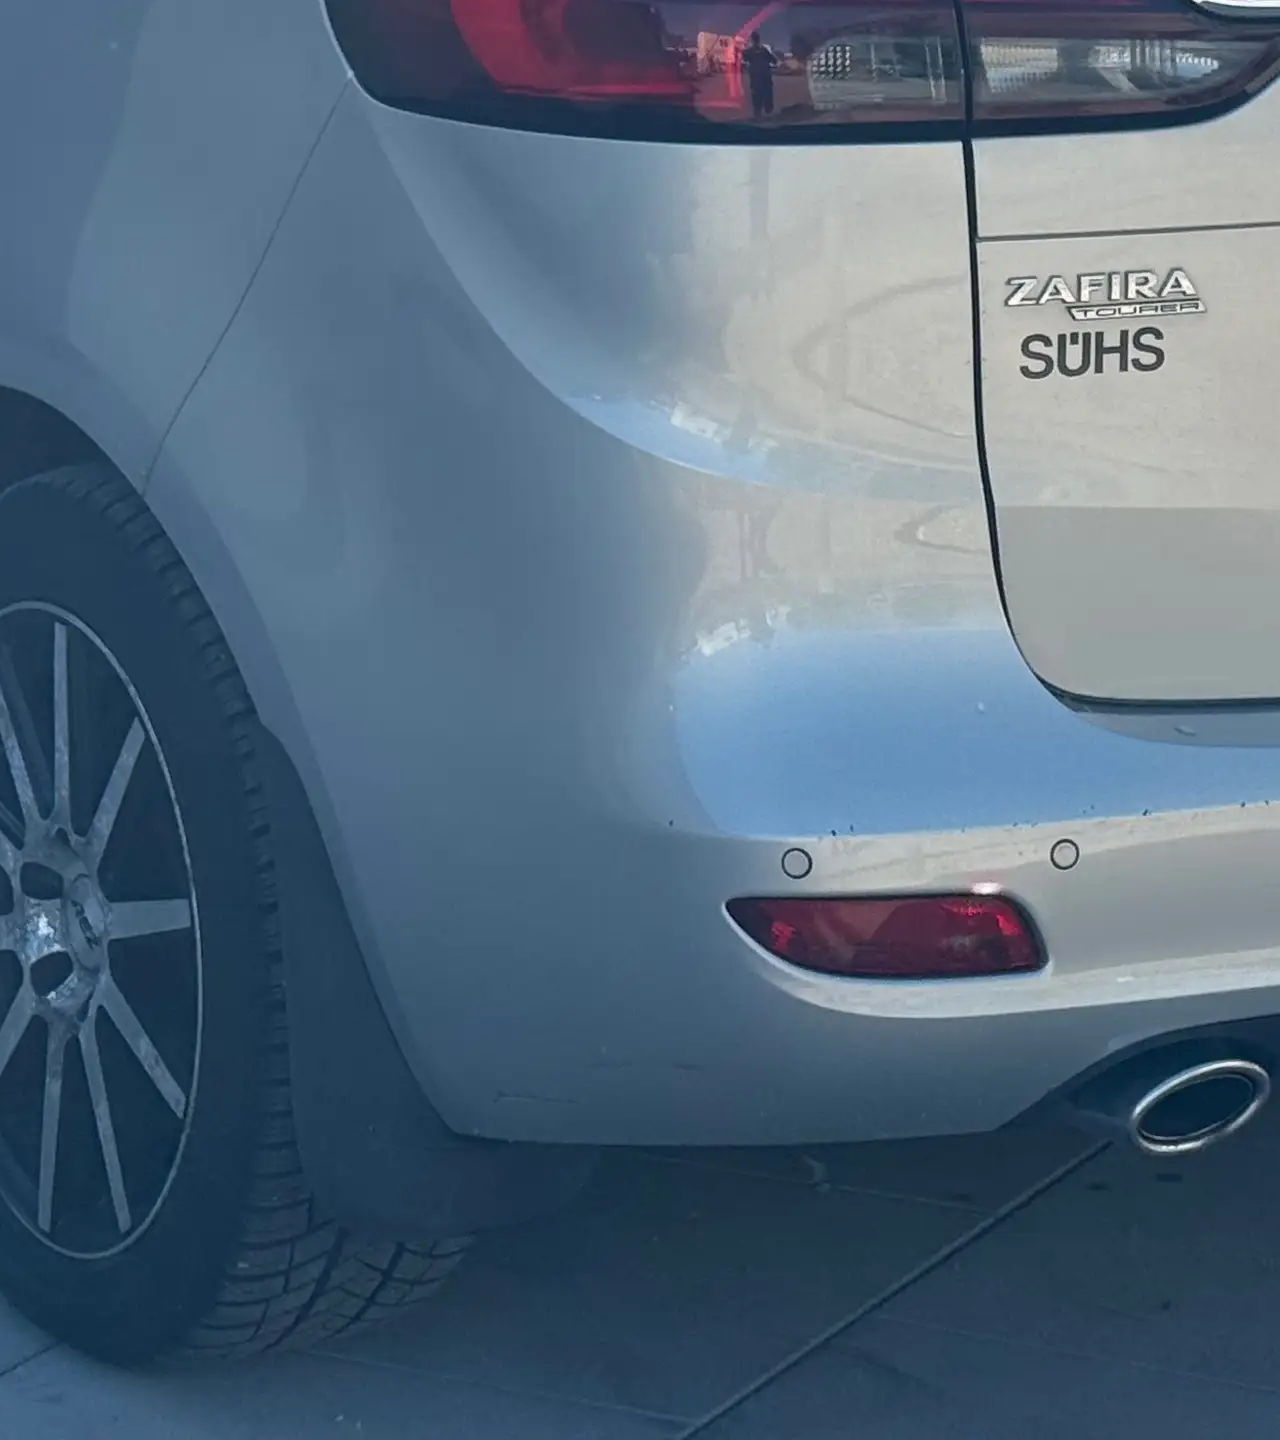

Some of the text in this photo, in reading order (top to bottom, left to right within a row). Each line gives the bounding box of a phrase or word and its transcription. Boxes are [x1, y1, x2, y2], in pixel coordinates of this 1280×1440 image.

[1004, 267, 1198, 308] ZAFIRA
[1076, 302, 1202, 318] TOURER
[1019, 326, 1166, 381] SÜHS
